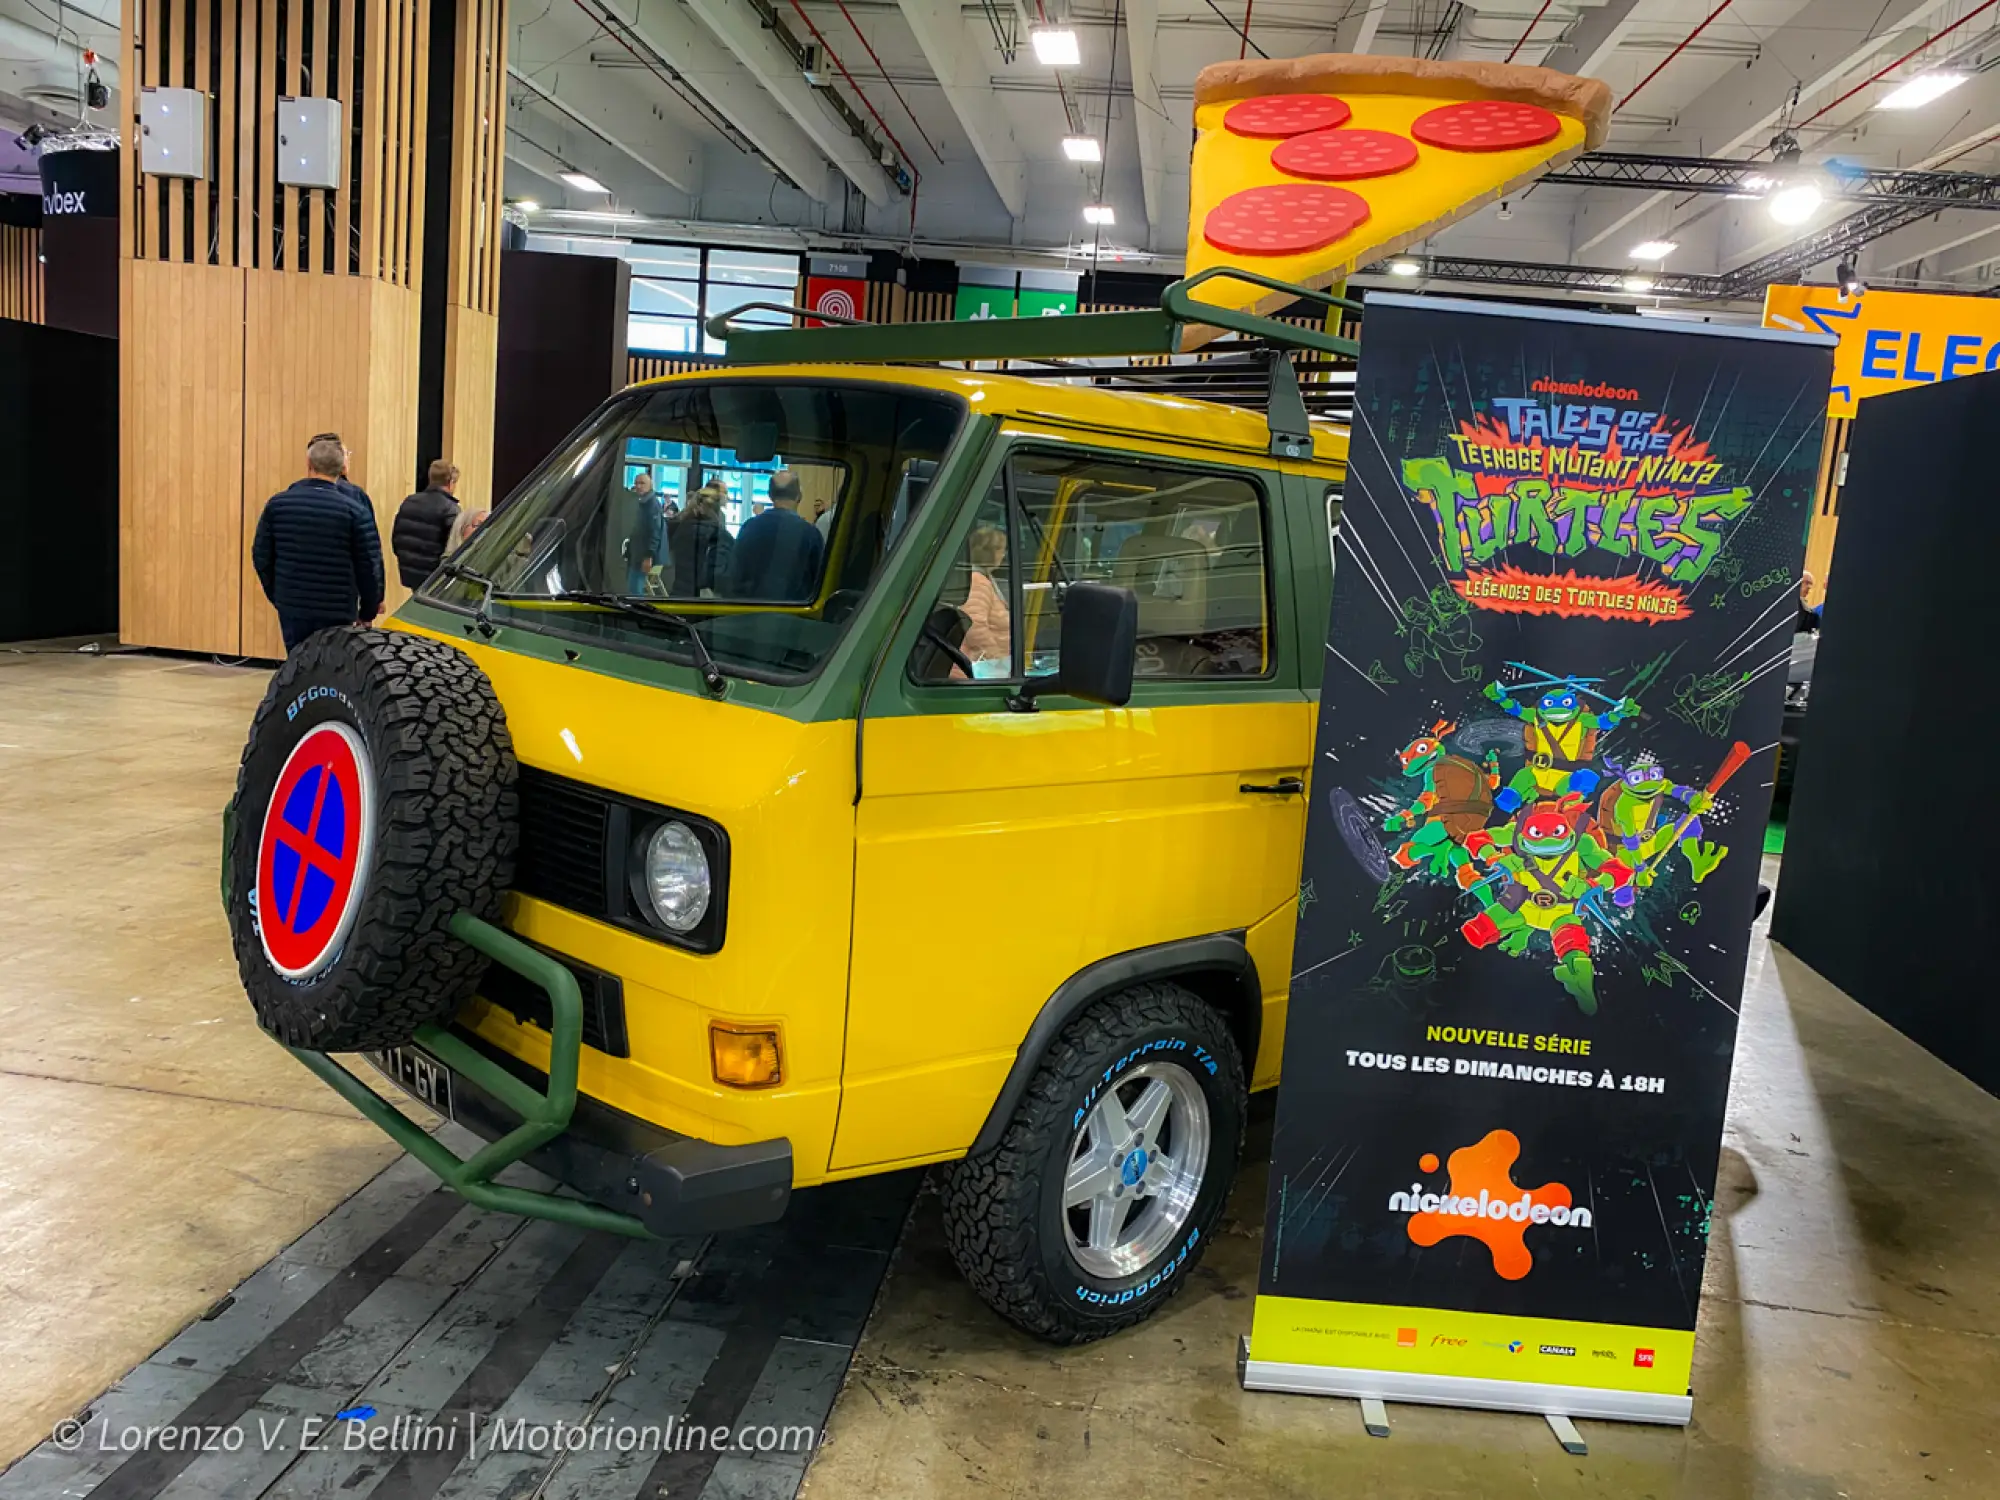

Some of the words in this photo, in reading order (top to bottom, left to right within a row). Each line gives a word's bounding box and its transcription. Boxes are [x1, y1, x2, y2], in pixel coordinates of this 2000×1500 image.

[1531, 376, 1638, 400] nickelodeon
[1492, 397, 1615, 446] TALES
[1620, 410, 1658, 429] OF
[1616, 430, 1673, 451] THE
[1400, 456, 1753, 583] TURTLES
[1535, 586, 1562, 604] DES
[1566, 587, 1634, 611] TORTUES
[1426, 1025, 1529, 1050] NOUVELLE
[1533, 1034, 1592, 1056] SÉRIE
[1346, 1050, 1406, 1071] TOUS
[1411, 1056, 1450, 1073] LES
[1454, 1059, 1593, 1088] DIMANCHES
[1597, 1068, 1615, 1089] À
[1619, 1076, 1665, 1094] 18H
[1389, 1183, 1593, 1228] nickelodeon
[1430, 1334, 1467, 1347] free
[1540, 1346, 1575, 1355] CANAL+
[1638, 1352, 1653, 1362] SFR
